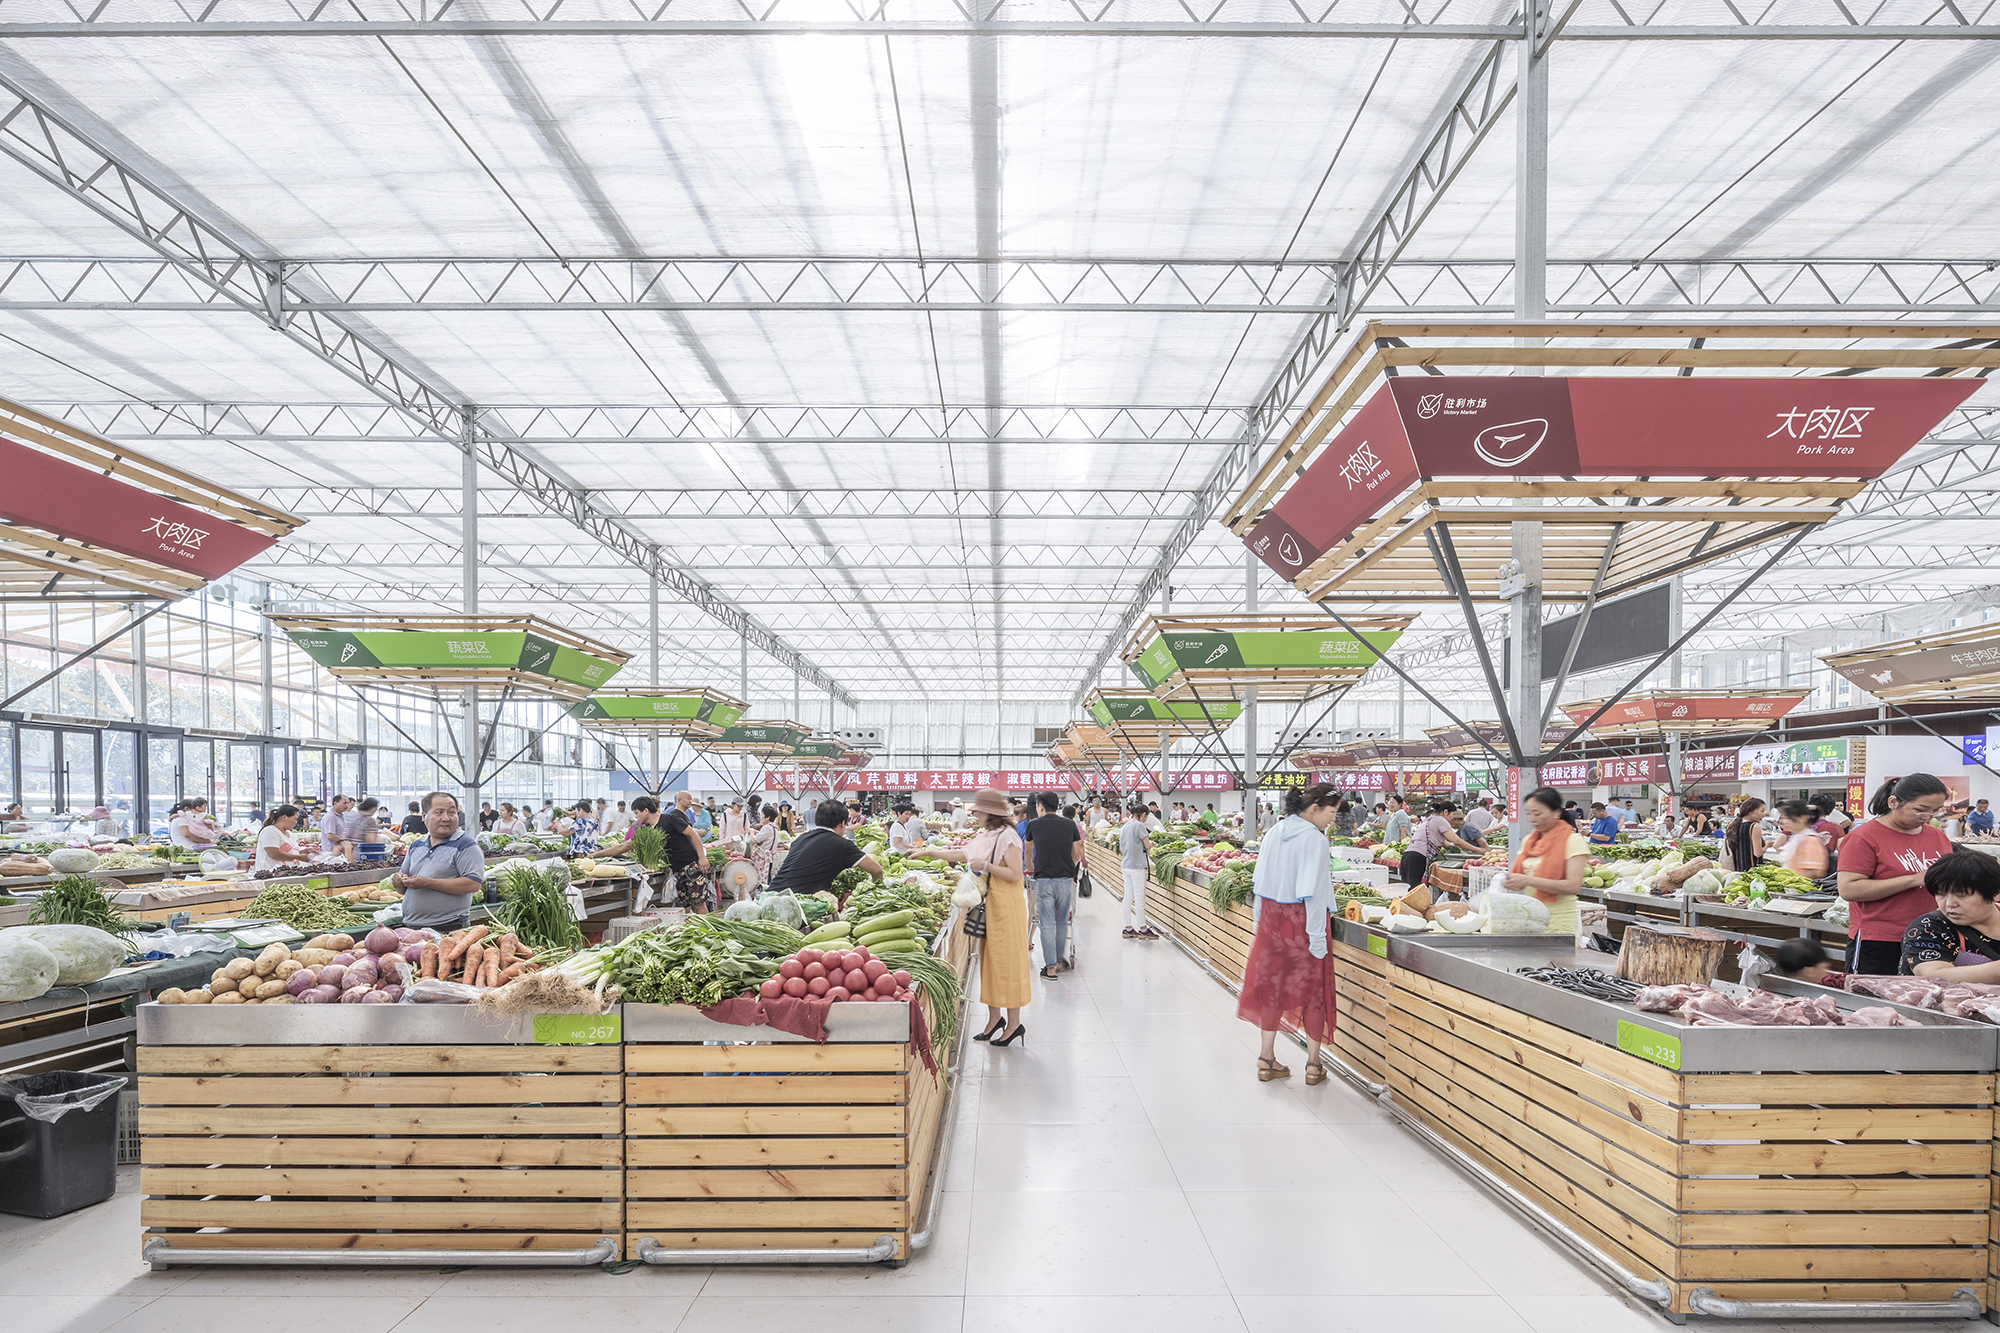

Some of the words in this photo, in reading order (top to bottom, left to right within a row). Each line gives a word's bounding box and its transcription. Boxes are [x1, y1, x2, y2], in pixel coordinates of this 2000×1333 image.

[1444, 398, 1487, 408] 胜利市场
[1767, 405, 1875, 439] 大肉区
[1796, 445, 1823, 454] Pork
[1827, 445, 1855, 454] Area
[1339, 440, 1382, 490] 大肉区
[1366, 478, 1379, 491] Pork
[1377, 469, 1391, 481] Area
[141, 516, 210, 550] 大肉区
[158, 542, 176, 553] Pork
[177, 549, 195, 559] Area
[446, 640, 490, 653] 蔬菜区
[1319, 640, 1361, 653] 蔬菜区
[1950, 647, 2000, 664] 牛羊肉区
[1540, 764, 1586, 780] 名府段记香油
[1604, 760, 1650, 778] 重庆面条
[930, 773, 990, 785] 太平辣椒
[1849, 786, 1862, 817] 馒头
[571, 1027, 614, 1039] NO.267
[1643, 1045, 1676, 1064] NO.233
